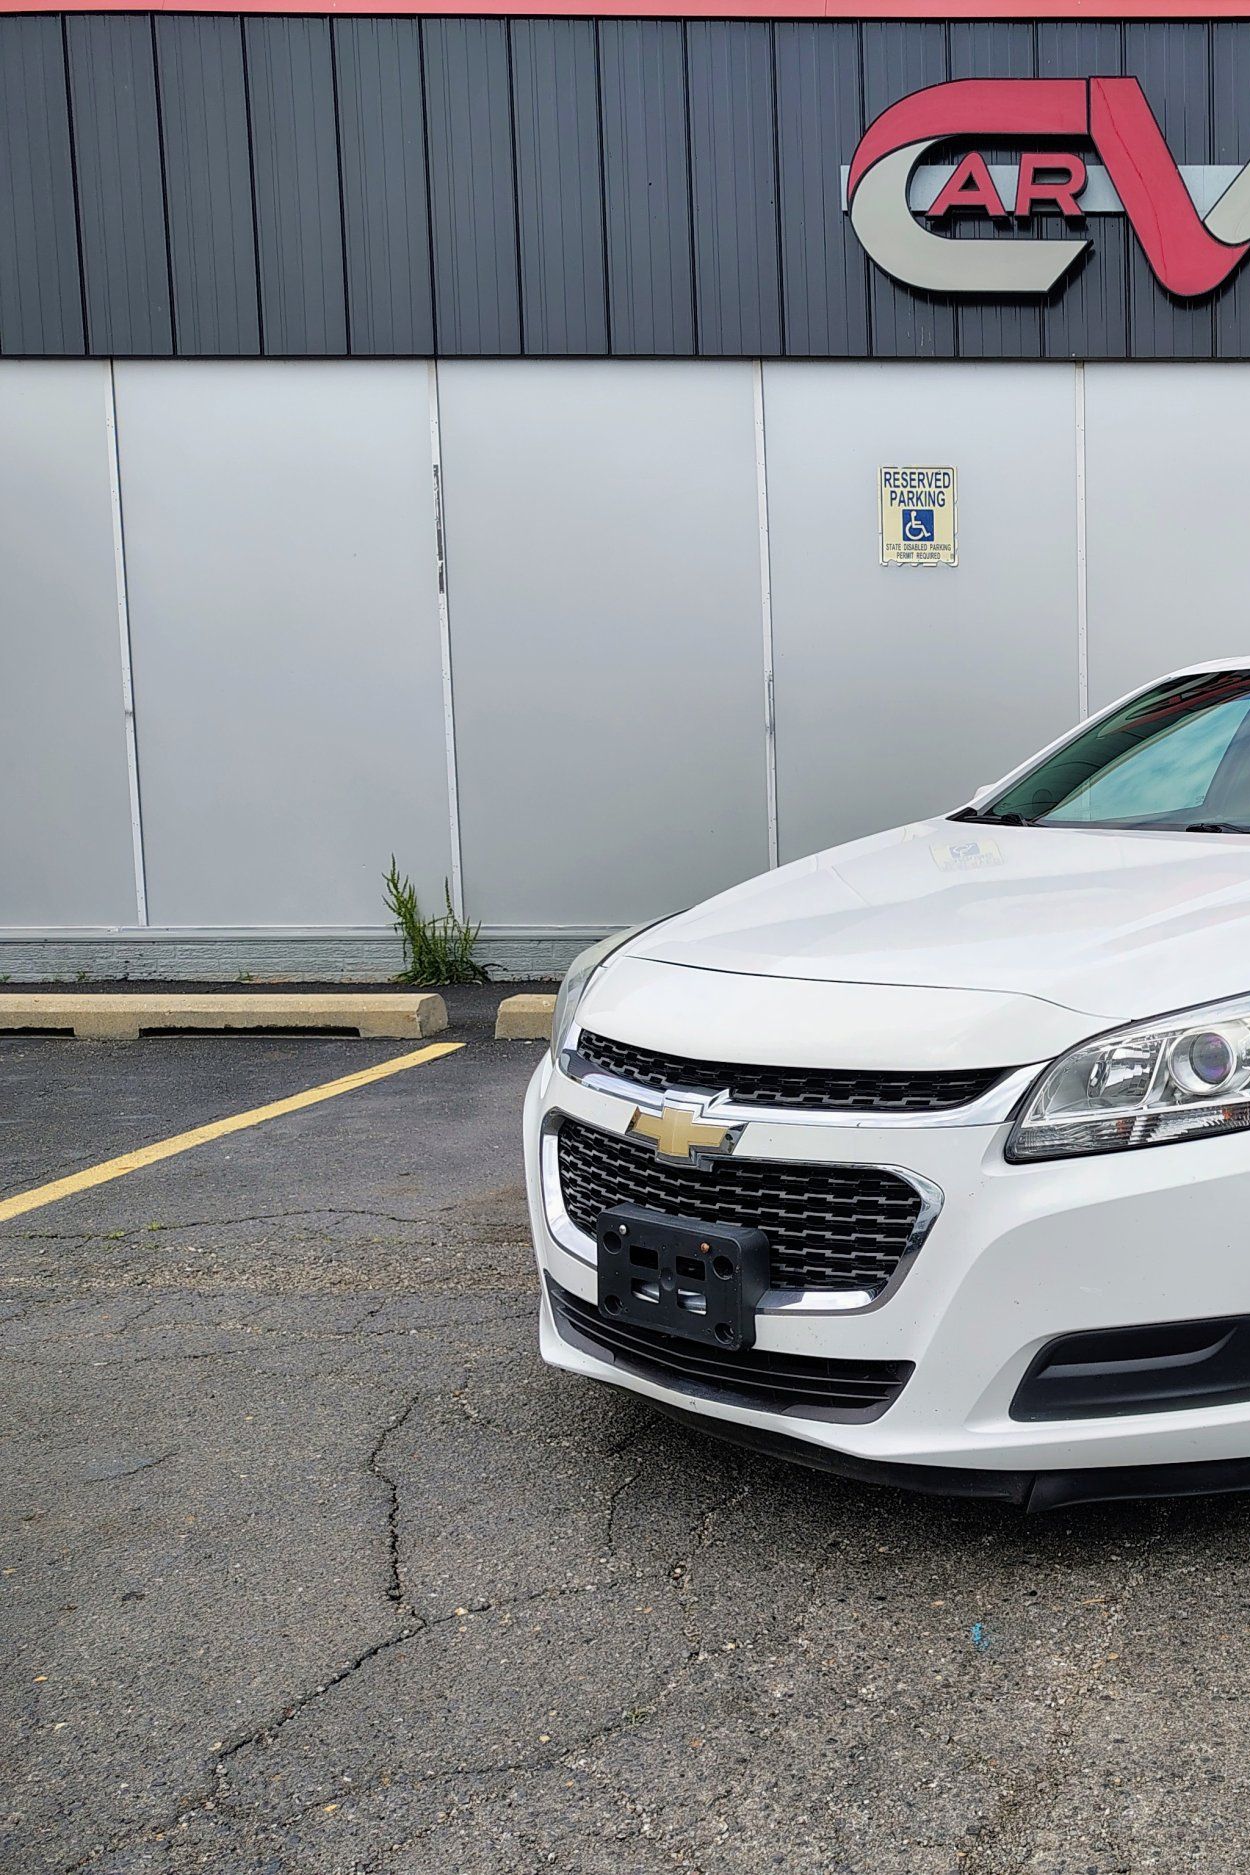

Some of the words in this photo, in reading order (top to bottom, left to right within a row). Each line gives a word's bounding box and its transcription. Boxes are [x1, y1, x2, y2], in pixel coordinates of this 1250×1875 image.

[884, 471, 951, 489] RESERVED
[890, 490, 946, 507] PARKING
[929, 543, 951, 551] PARKING
